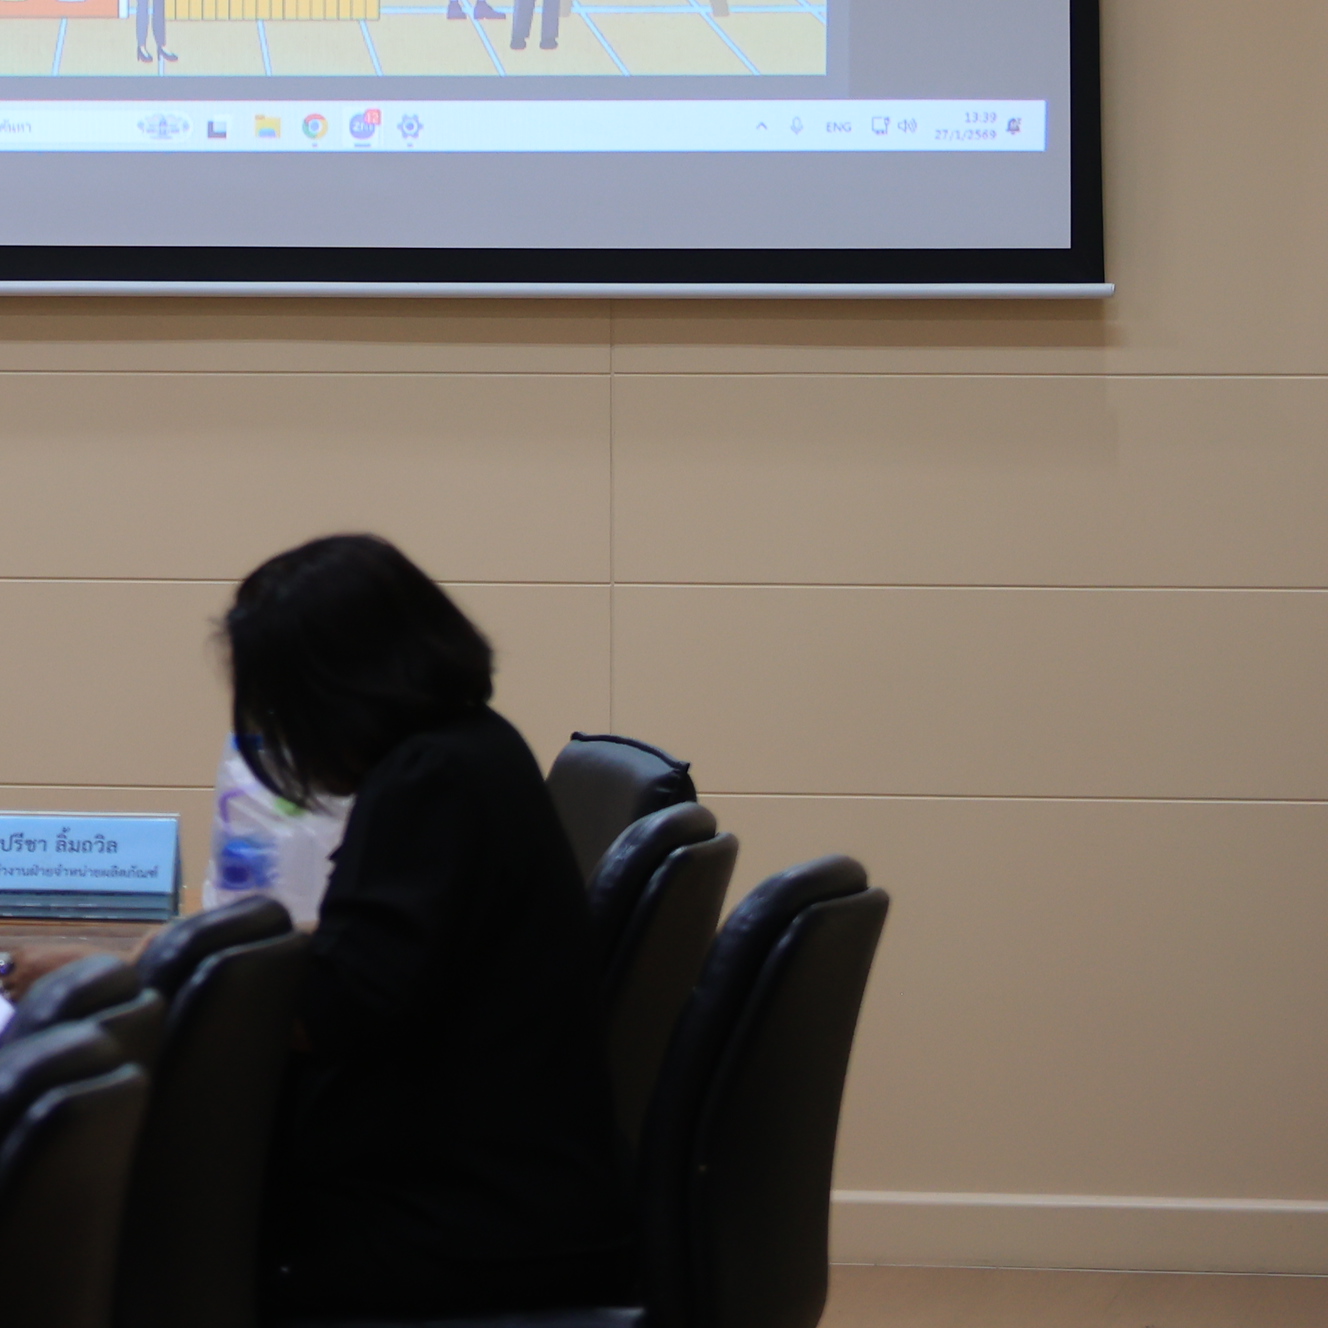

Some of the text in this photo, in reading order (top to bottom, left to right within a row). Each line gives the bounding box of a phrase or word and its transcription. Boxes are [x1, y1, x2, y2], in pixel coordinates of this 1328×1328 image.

[825, 120, 852, 133] ENG
[54, 825, 120, 856] ลิ้มถวิล
